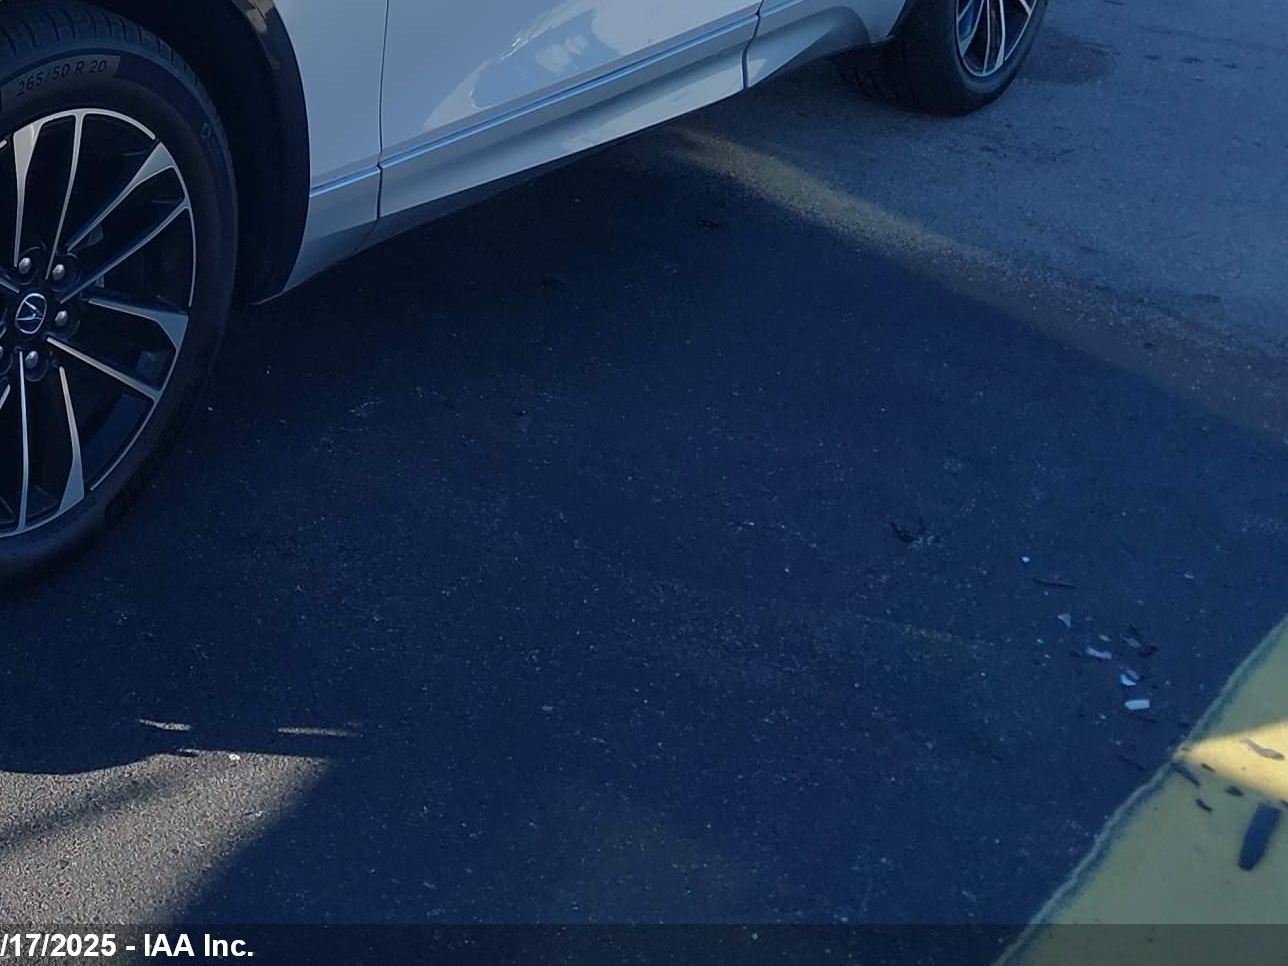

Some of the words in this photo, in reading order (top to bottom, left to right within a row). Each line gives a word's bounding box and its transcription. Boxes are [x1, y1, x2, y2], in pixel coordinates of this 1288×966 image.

[15, 61, 71, 97] 265/50
[74, 60, 86, 76] R
[89, 58, 108, 74] 20
